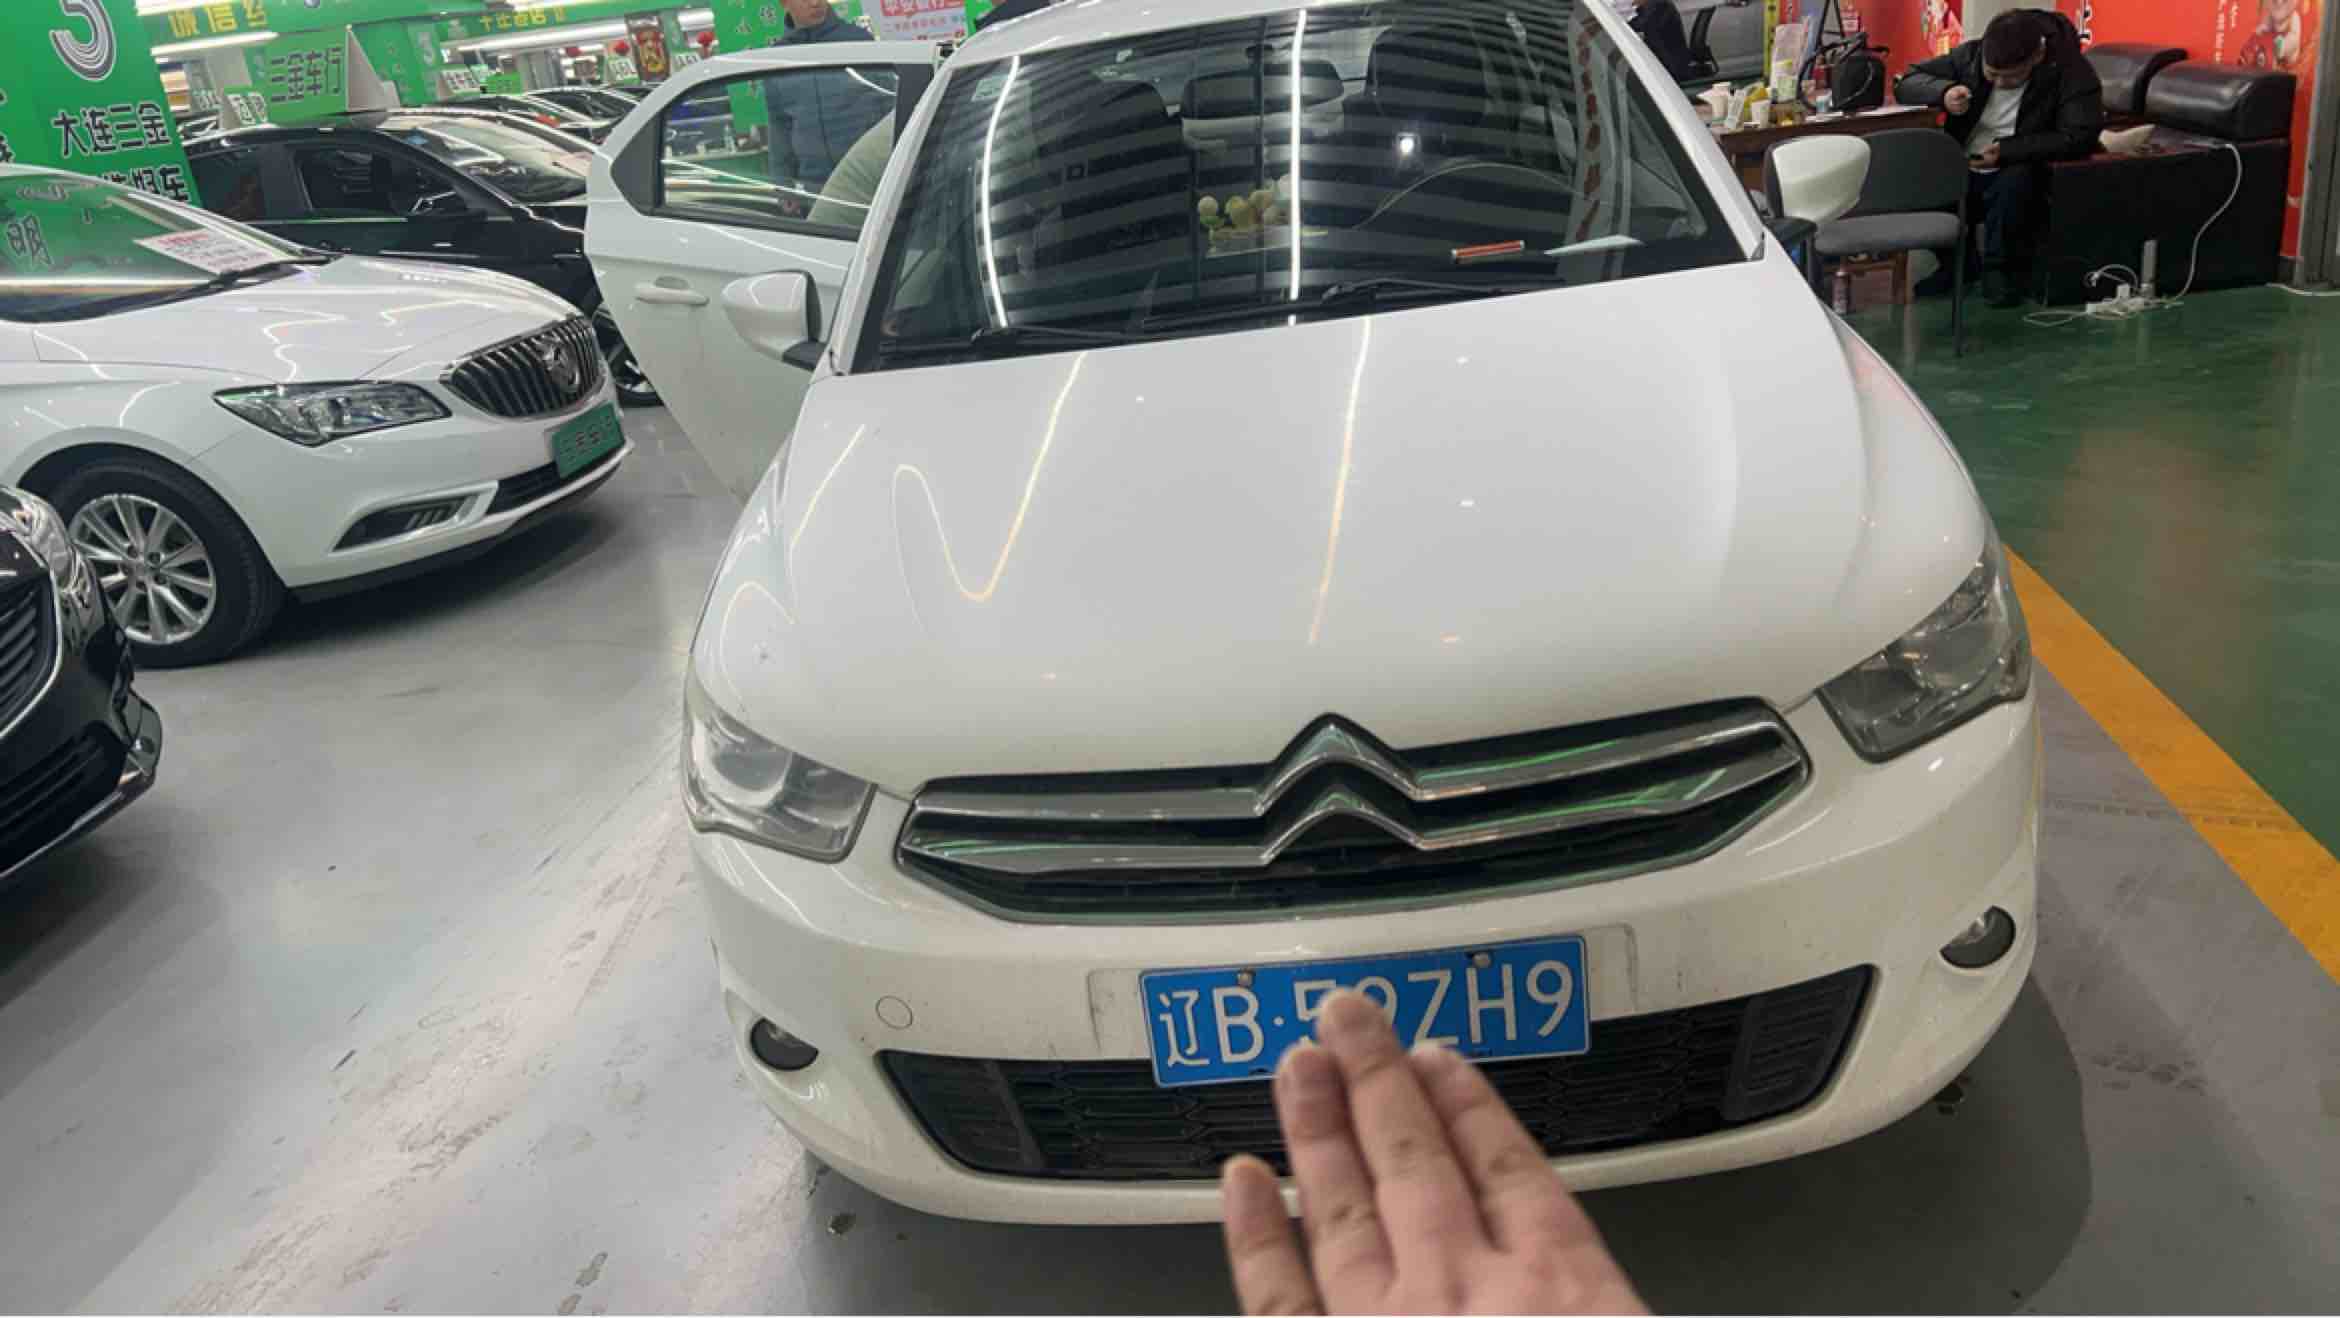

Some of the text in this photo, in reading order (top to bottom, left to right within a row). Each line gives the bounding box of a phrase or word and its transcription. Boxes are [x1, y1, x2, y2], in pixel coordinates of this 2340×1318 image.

[271, 47, 343, 103] 三金车行
[51, 102, 172, 158] 大连三金
